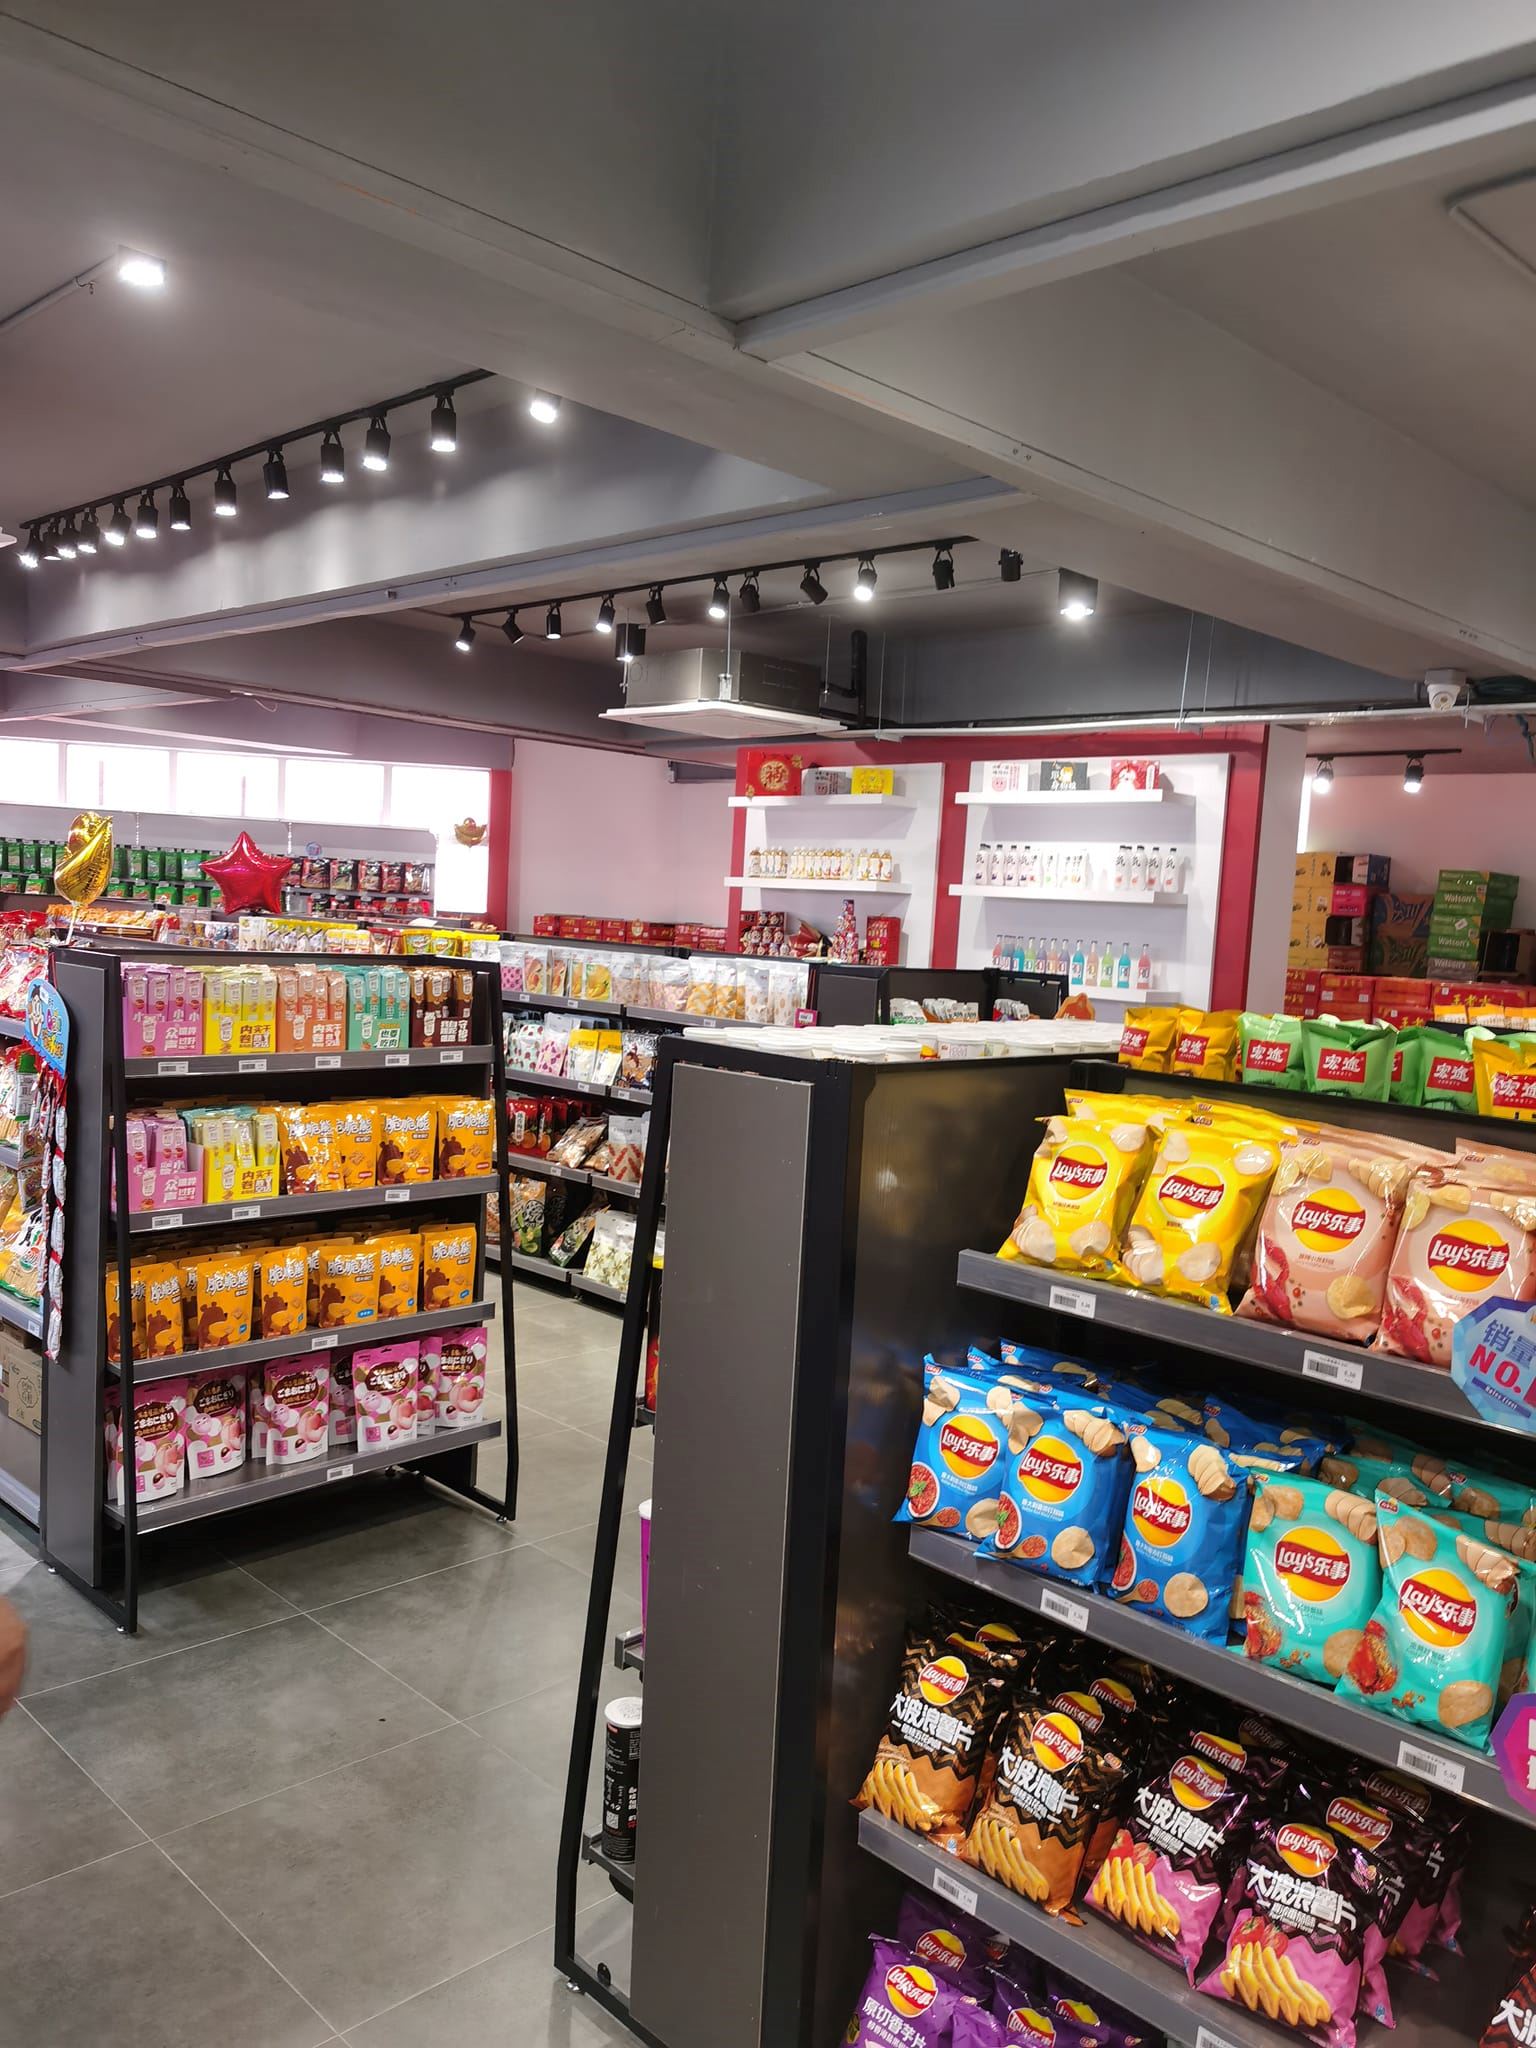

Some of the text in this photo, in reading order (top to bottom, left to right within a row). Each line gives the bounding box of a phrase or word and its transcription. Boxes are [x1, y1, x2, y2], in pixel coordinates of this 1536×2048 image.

[1052, 1163, 1106, 1185] Lay's乐事
[1162, 1178, 1225, 1206] Lay's乐事
[1293, 1203, 1366, 1235] Lay's乐事
[1429, 1238, 1509, 1271] Lay's乐事
[941, 1428, 997, 1462] Lay's乐事
[1020, 1450, 1082, 1486] Lay's乐事
[1134, 1489, 1191, 1528] Lay's乐事
[1276, 1546, 1349, 1581] Lay's乐事
[1401, 1585, 1476, 1628] Lay's乐事
[924, 1664, 967, 1694] Lay's乐事
[889, 1691, 976, 1752] 大波浪薯片
[1036, 1724, 1084, 1762] Lay's乐事
[998, 1746, 1080, 1820] 大波浪薯片
[1173, 1761, 1224, 1798] Lay's乐事
[1133, 1786, 1226, 1857] 大波浪薯片
[1330, 1801, 1389, 1840] Lay's乐事
[1278, 1827, 1338, 1864] Lay's乐事
[1246, 1864, 1357, 1932] 大波浪薯片
[917, 1935, 967, 1970] Lay's乐事
[888, 1968, 934, 2007] Lay's乐事
[862, 1996, 928, 2048] 原切香芋片
